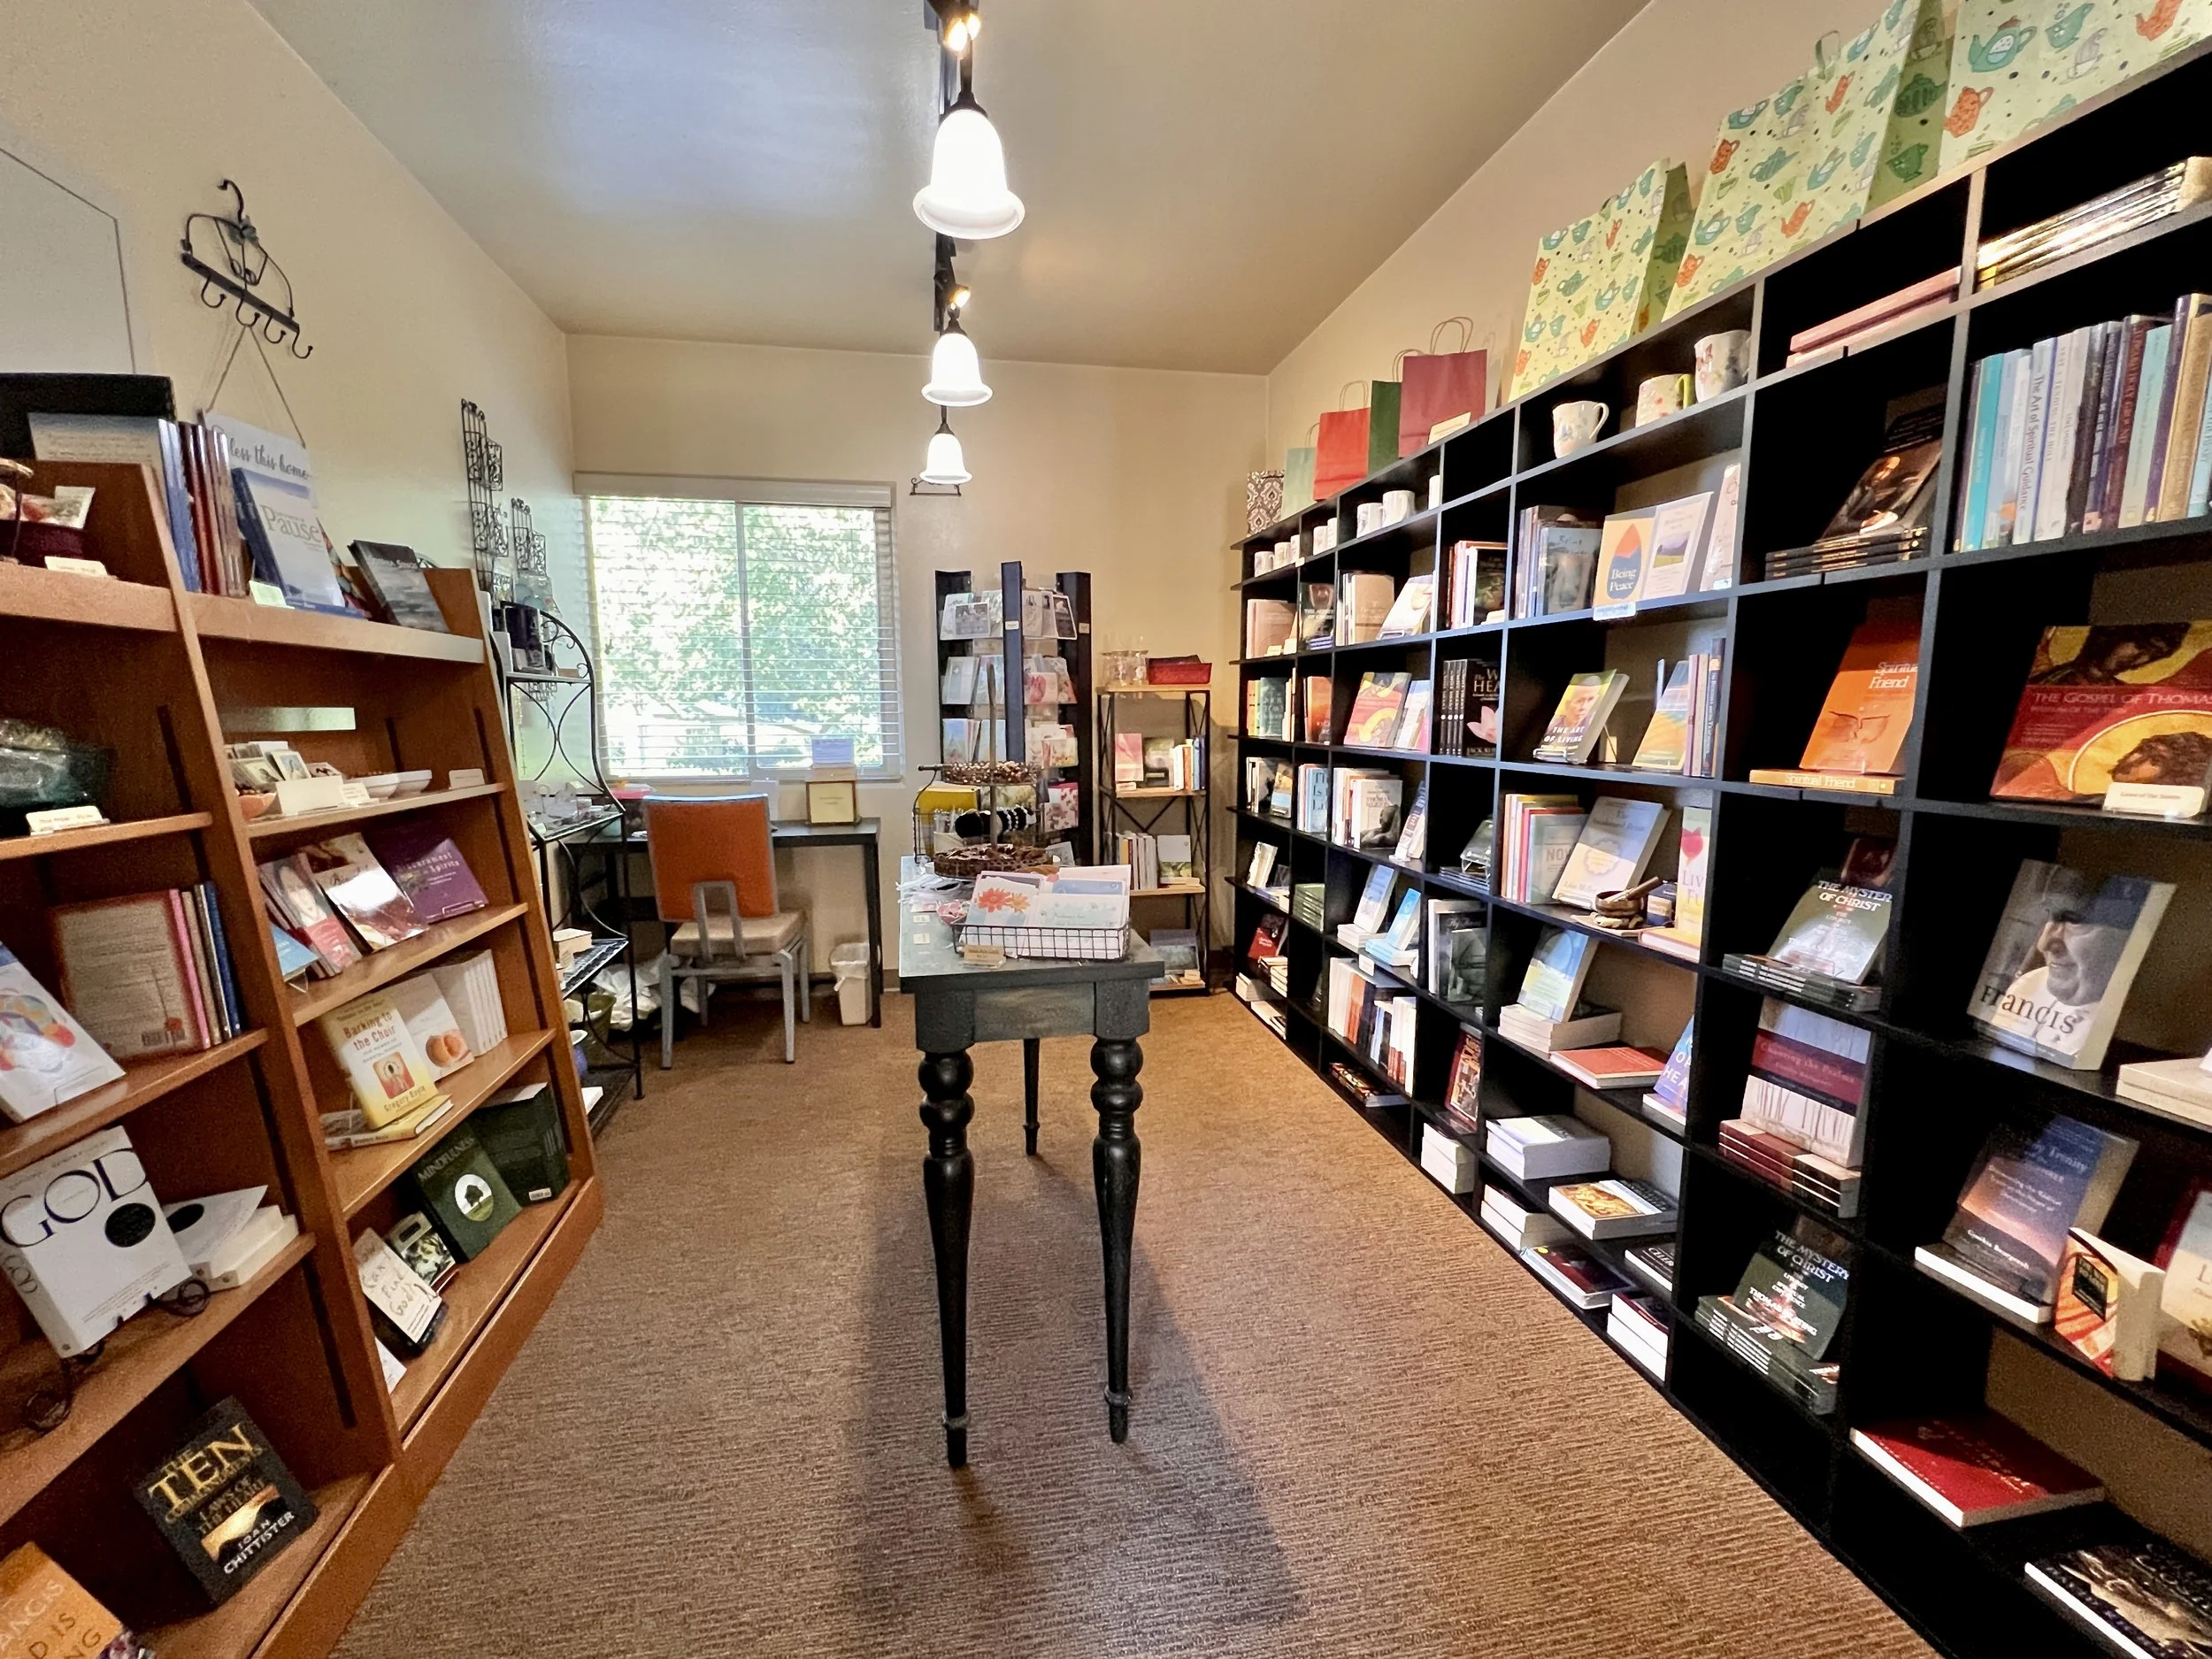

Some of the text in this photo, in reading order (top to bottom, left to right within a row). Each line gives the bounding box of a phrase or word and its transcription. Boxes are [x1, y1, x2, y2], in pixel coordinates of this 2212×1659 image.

[2032, 375, 2044, 392] The
[2030, 393, 2042, 415] Art
[254, 445, 277, 470] this
[259, 503, 323, 542] Pause
[1609, 581, 1634, 592] Peace
[1611, 568, 1636, 580] Being
[1869, 676, 1909, 689] Friend
[2035, 692, 2212, 704] THE GOSPEL OF THOMAS
[1784, 773, 1855, 788] Spiritual Friend
[1817, 880, 1841, 892] THE
[1819, 892, 1881, 911] OF CHRIST
[1979, 986, 2075, 1034] Francis
[342, 1011, 393, 1039] Barking to
[354, 1036, 371, 1051] the
[371, 1025, 396, 1042] Choir
[418, 1137, 475, 1182] MINDFULNESS
[1, 1148, 147, 1248] GOD
[1775, 1230, 1850, 1280] THE MYSTERY
[1777, 1245, 1834, 1283] OF CHRIST
[3, 1254, 38, 1294] GOD
[148, 1423, 253, 1509] TEN
[161, 1449, 194, 1473] THE
[223, 1511, 295, 1574] CHITTISTER
[237, 1518, 271, 1549] JOAN
[50, 1612, 76, 1640] IS
